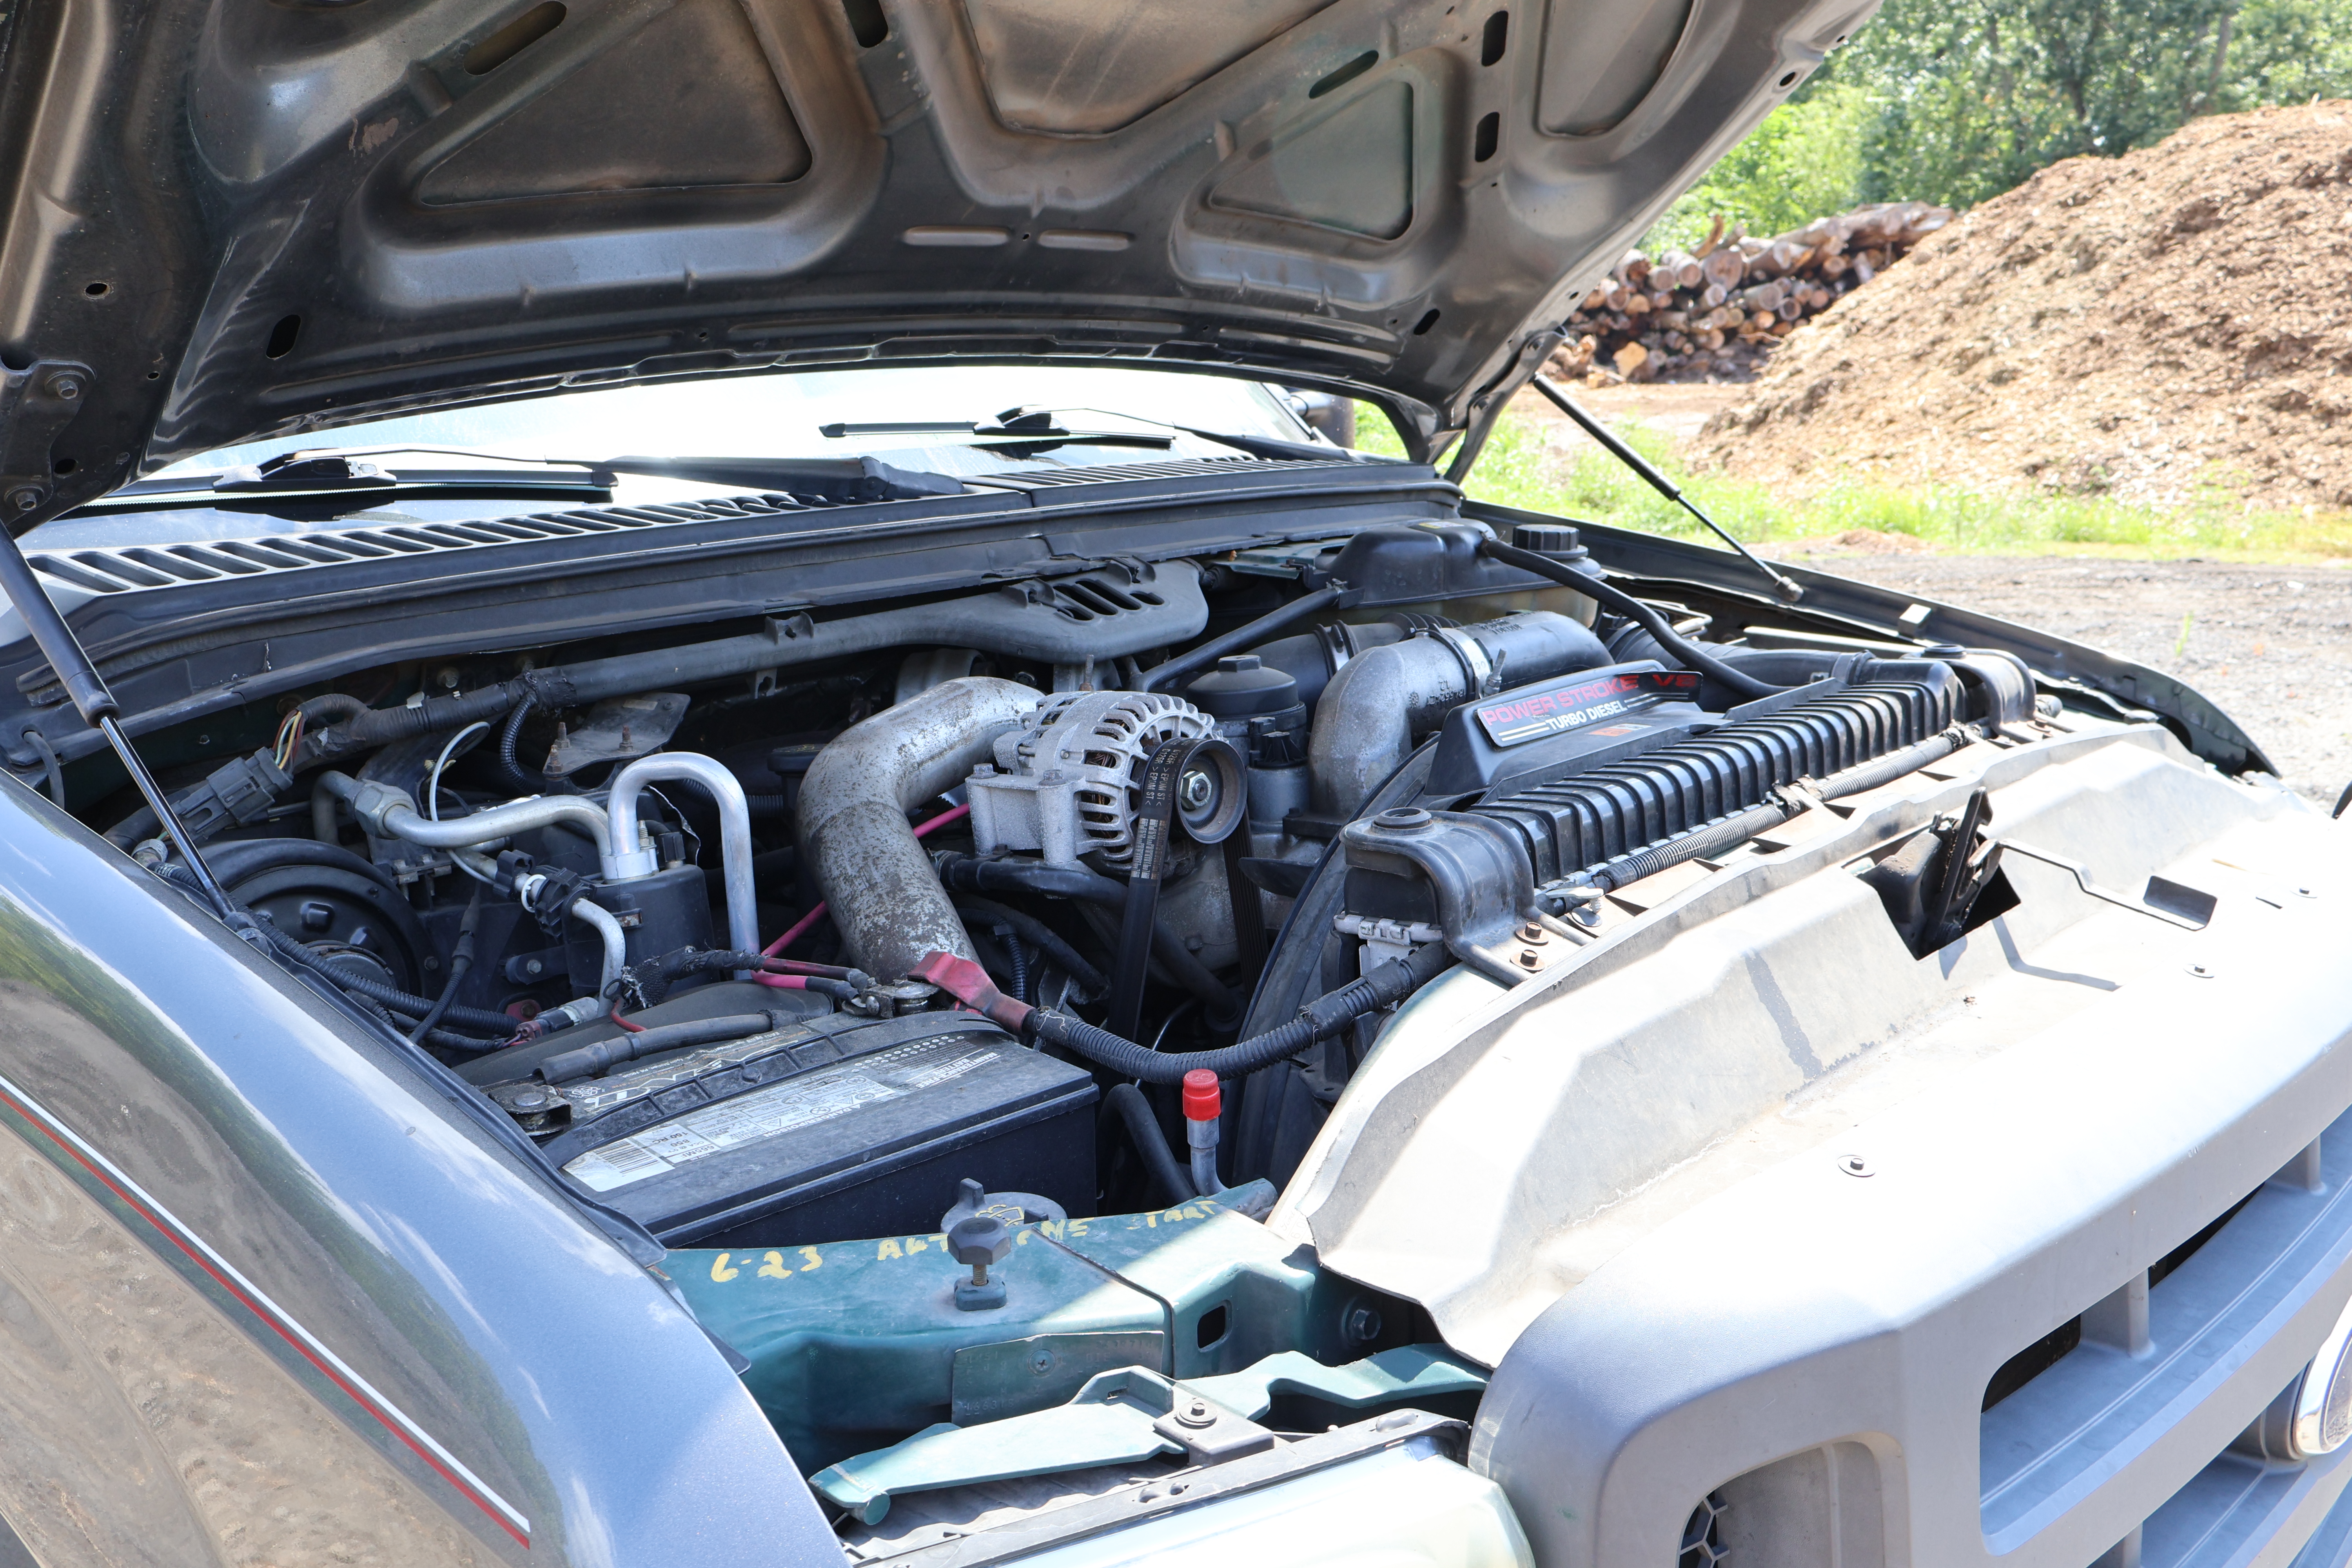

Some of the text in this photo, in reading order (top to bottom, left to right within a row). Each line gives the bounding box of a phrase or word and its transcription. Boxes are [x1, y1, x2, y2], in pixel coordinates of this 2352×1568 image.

[1482, 674, 1697, 726] POWER STROKE V8
[1545, 710, 1587, 730] TURBO
[1586, 700, 1628, 720] DIESEL
[915, 1052, 997, 1088] MAINTENANCE-FREE
[931, 1058, 970, 1075] BATTERY
[761, 1107, 853, 1137] DANGER/POISON
[669, 1139, 690, 1147] 850
[678, 1145, 715, 1158] 665MF
[1280, 1210, 1296, 1231] Ford
